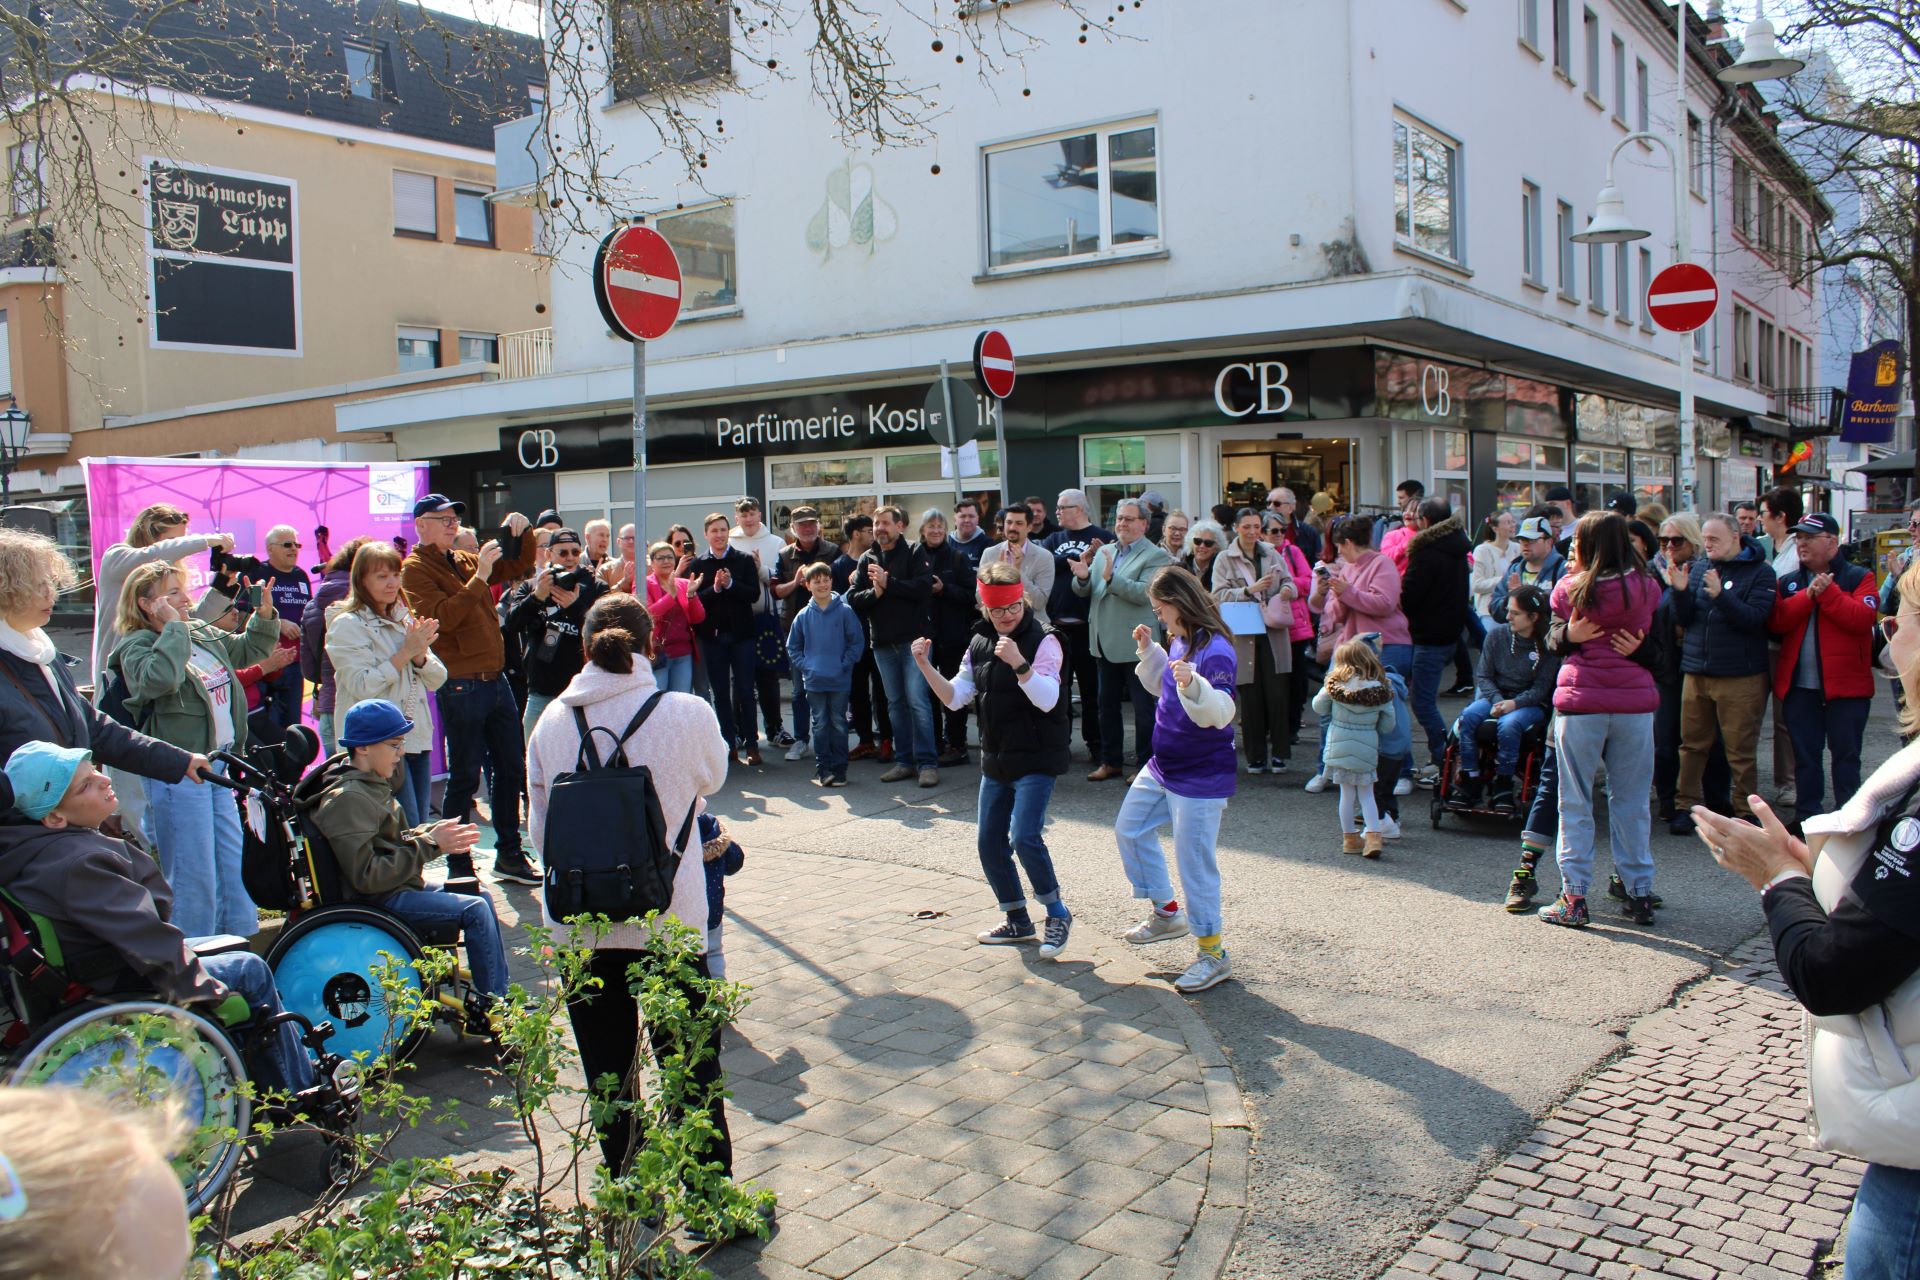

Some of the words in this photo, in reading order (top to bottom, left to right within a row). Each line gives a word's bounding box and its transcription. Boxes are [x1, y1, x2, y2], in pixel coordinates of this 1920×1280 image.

[155, 174, 287, 211] Schuhmacher
[222, 209, 287, 246] Lupp
[1214, 361, 1294, 418] CB
[1422, 364, 1451, 417] CB
[716, 406, 855, 447] Parfümerie
[868, 393, 998, 435] Kosik
[517, 429, 559, 469] CB
[1895, 866, 1911, 877] WEEK
